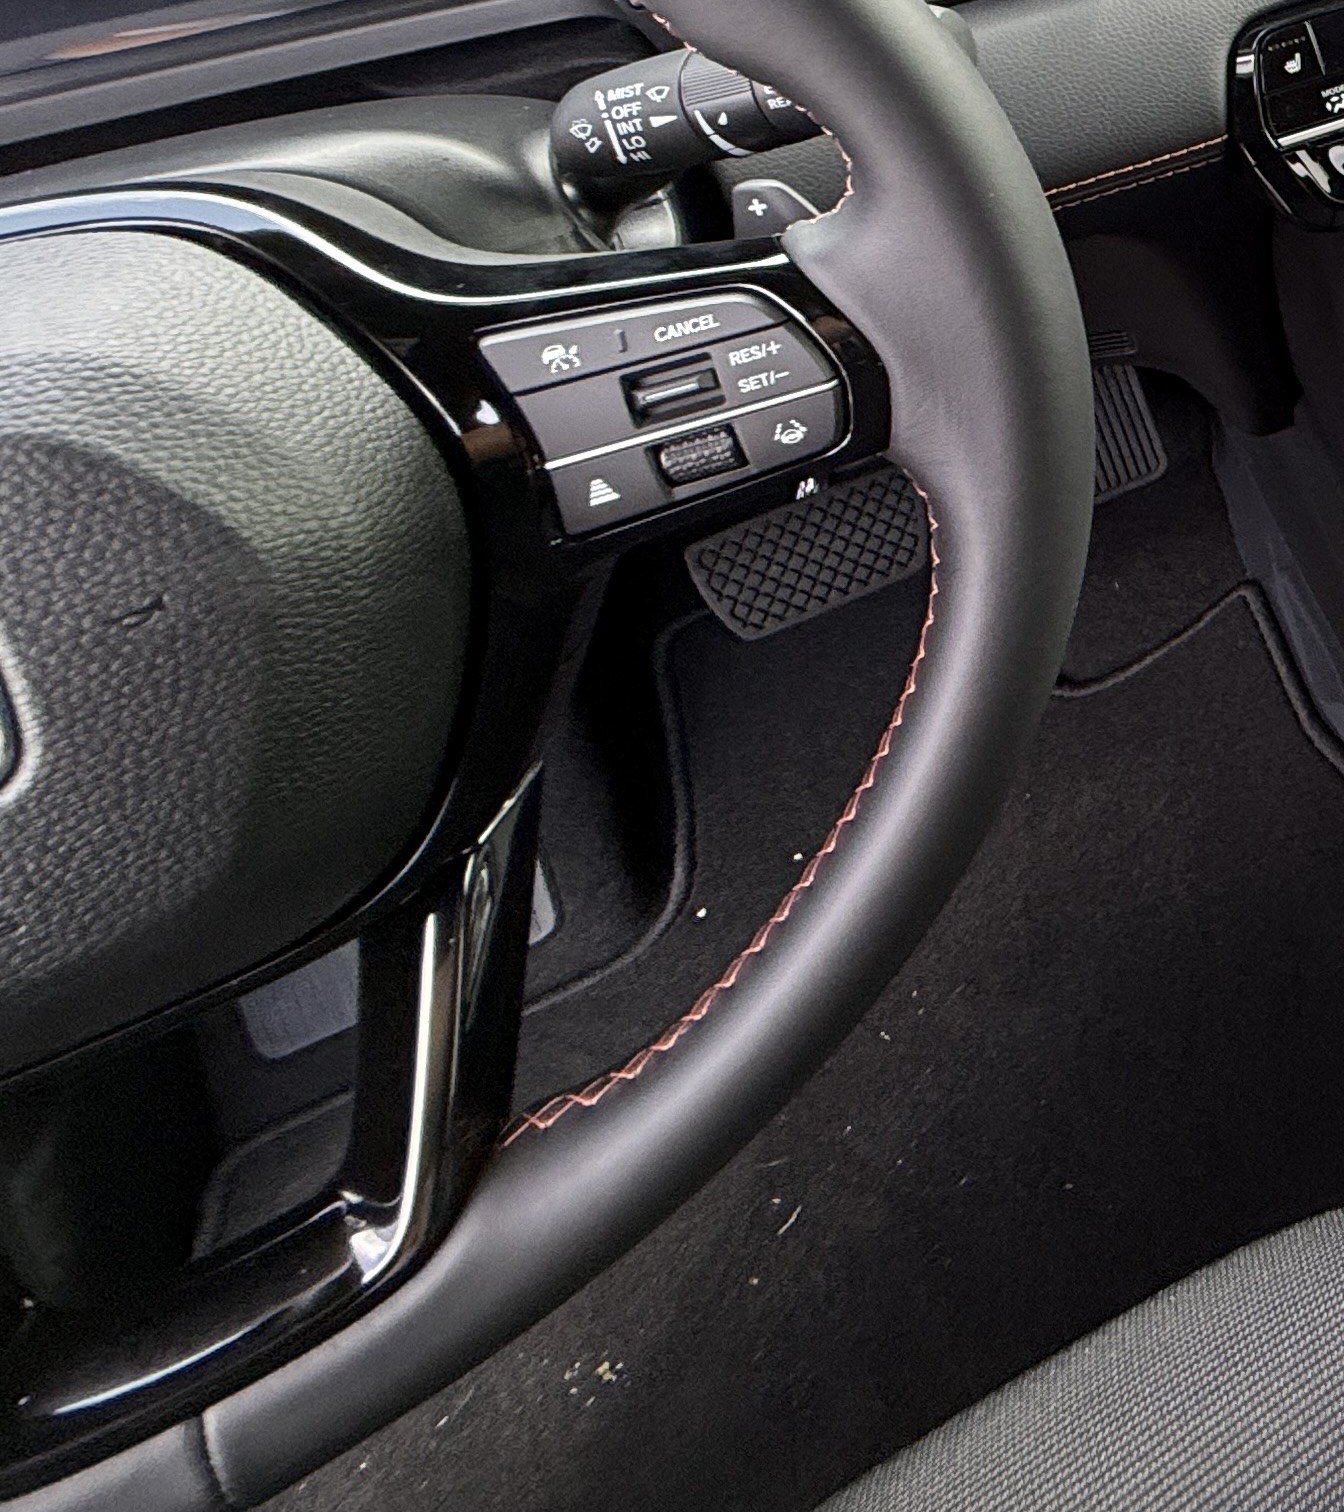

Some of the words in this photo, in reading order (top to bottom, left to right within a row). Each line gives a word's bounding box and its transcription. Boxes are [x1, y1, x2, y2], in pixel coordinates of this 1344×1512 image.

[606, 82, 645, 102] MIST
[611, 101, 643, 120] OFF
[616, 118, 644, 136] INT
[622, 135, 648, 151] LO
[629, 150, 653, 163] HI
[653, 313, 721, 342] CANCEL
[728, 340, 783, 367] RES/+
